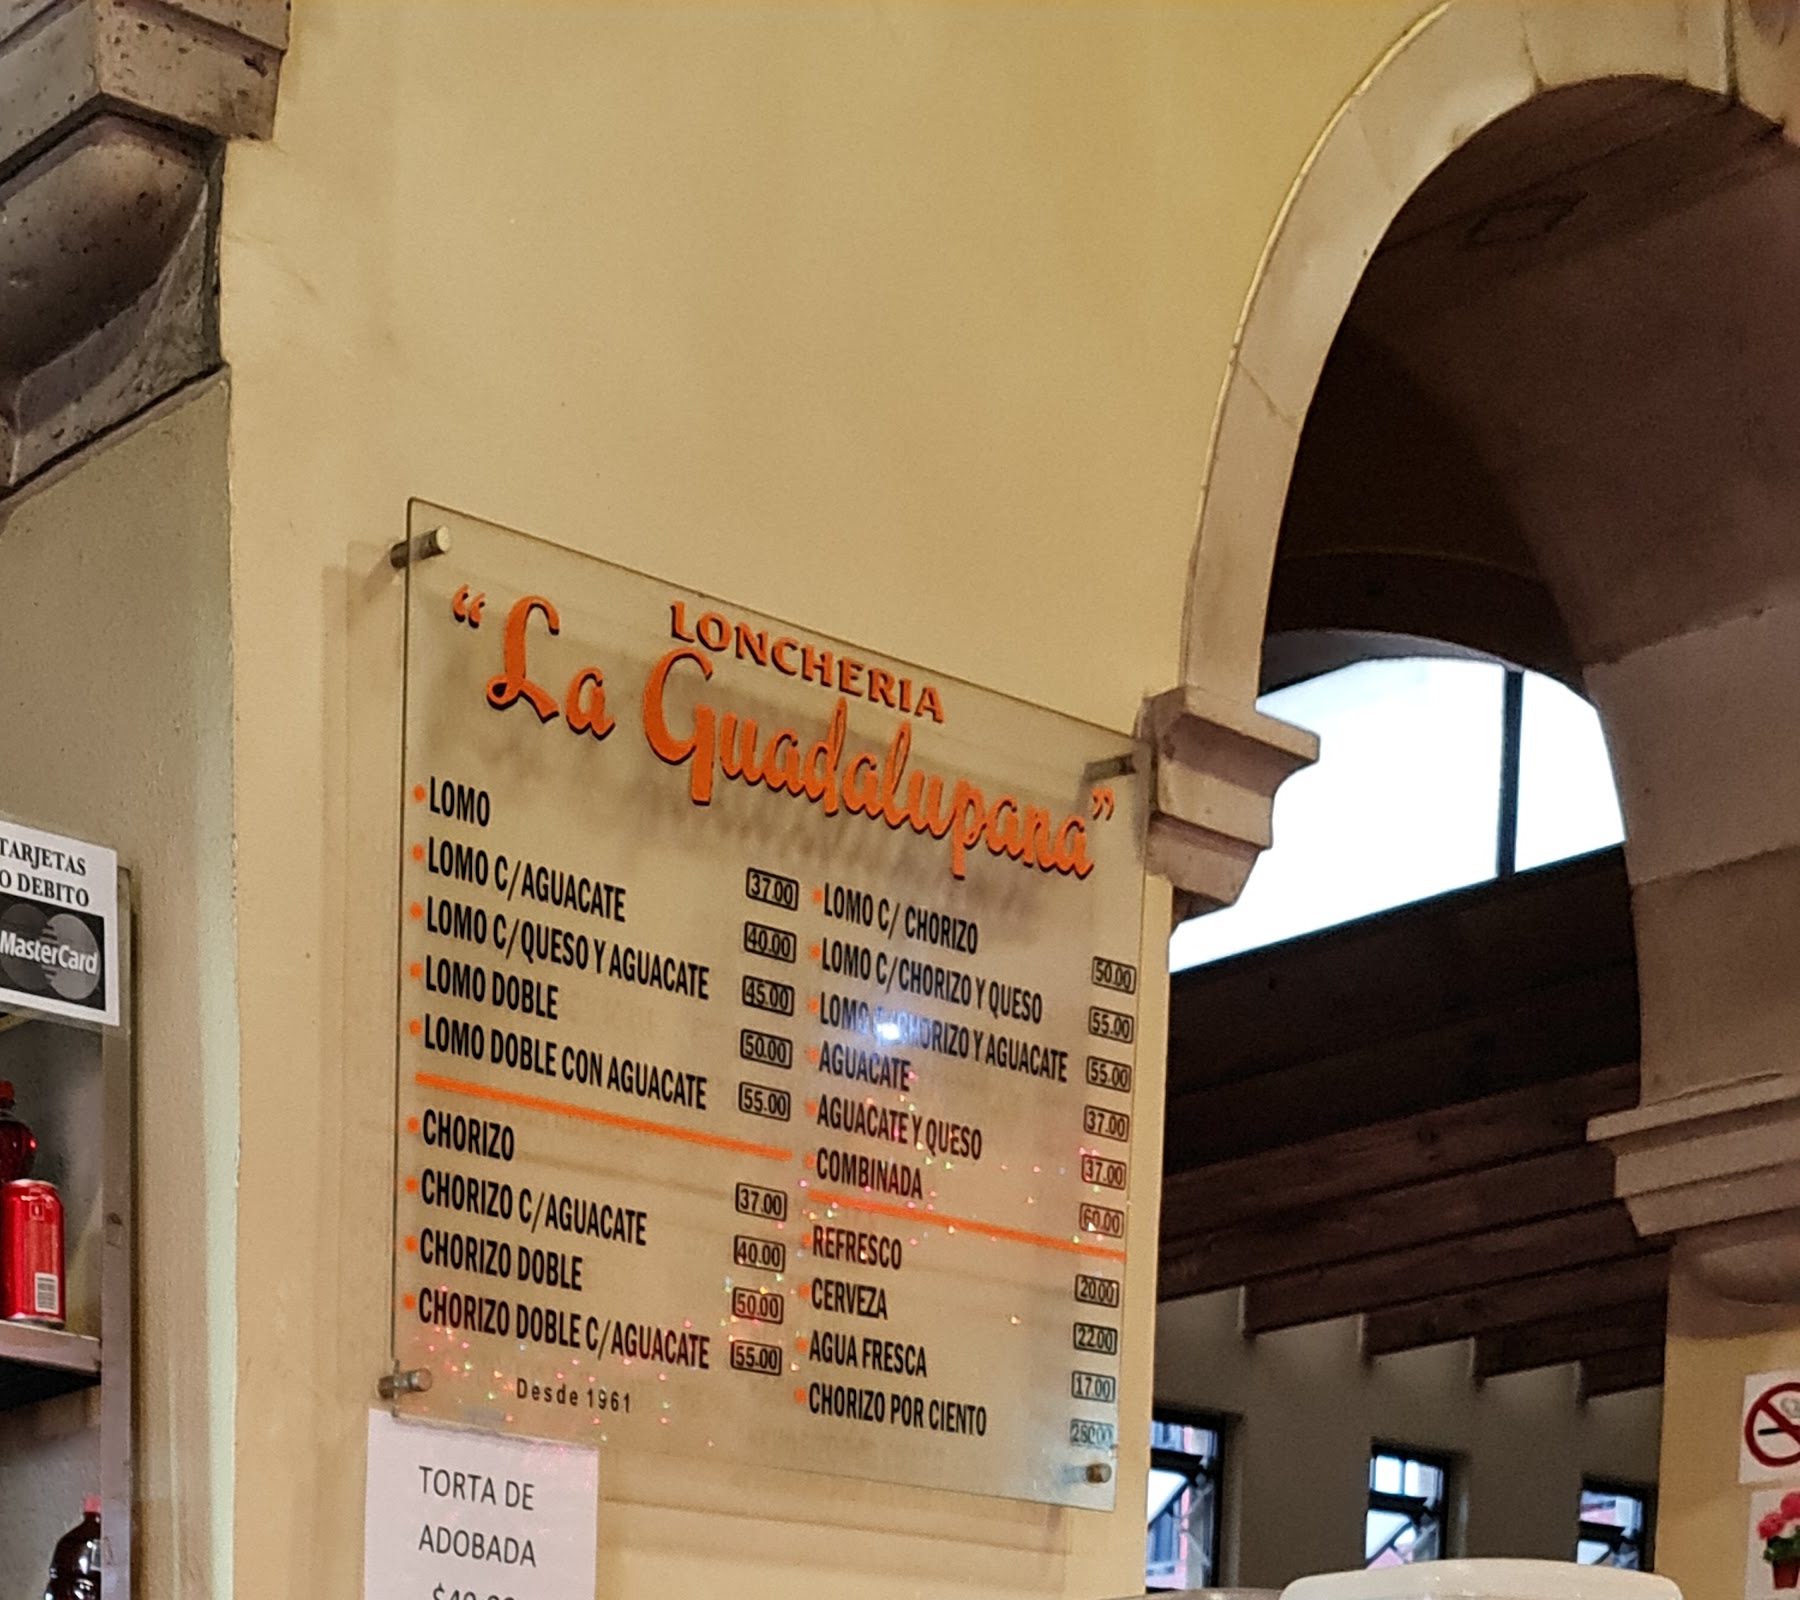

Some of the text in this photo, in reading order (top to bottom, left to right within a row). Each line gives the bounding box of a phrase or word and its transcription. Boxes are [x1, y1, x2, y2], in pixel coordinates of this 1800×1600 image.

[670, 601, 945, 724] LONCHERIA
[429, 776, 491, 827] LOMO
[427, 835, 489, 887] LOMO
[17, 873, 90, 908] DEBITO
[750, 873, 795, 907] 37.00
[823, 881, 874, 928] LOMO
[904, 906, 979, 955] CHORIZO
[426, 895, 487, 945] LOMO
[593, 938, 610, 974] Y
[608, 947, 710, 1000] AGUACATE
[746, 926, 792, 960] 40.00
[425, 954, 559, 1021] LOMO DOBLE
[745, 980, 791, 1011] 45.00
[821, 937, 872, 983] LOMO
[975, 976, 987, 1010] Y
[989, 980, 1043, 1025] QUESO
[1094, 960, 1132, 991] 50.00
[819, 991, 870, 1036] LOMO
[973, 1029, 985, 1063] Y
[985, 1034, 1069, 1083] AGUACATE
[1092, 1011, 1130, 1039] 55.00
[424, 1012, 707, 1111] LOMO DOBLE CON AGUACATE
[745, 1033, 788, 1065] 50.00
[818, 1040, 912, 1092] AGUACATE
[1090, 1061, 1129, 1088] 55.00
[743, 1086, 787, 1117] 55.00
[1087, 1110, 1126, 1138] 37.00
[422, 1108, 515, 1162] CHORIZO
[816, 1094, 982, 1161] AGUACATE Y QUESO
[420, 1167, 514, 1221] CHORIZO
[815, 1147, 924, 1201] COMBINADA
[739, 1188, 783, 1218] 37.00
[419, 1227, 584, 1292] CHORIZO DOBLE
[736, 1239, 781, 1269] 40.00
[811, 1224, 903, 1271] REFRESCO
[418, 1286, 510, 1337] CHORIZO
[515, 1303, 581, 1349] DOBLE
[735, 1292, 780, 1320] 50.00
[811, 1277, 889, 1321] CERVEZA
[734, 1344, 778, 1372] 55.00
[809, 1330, 928, 1378] AGUA FRESCA
[515, 1377, 631, 1413] Desde 1961
[808, 1382, 988, 1437] CHORIZO POR CIENTO
[1075, 1376, 1111, 1400] 17.00
[418, 1465, 535, 1511] TORTA DE
[418, 1524, 537, 1568] ADOBADA
